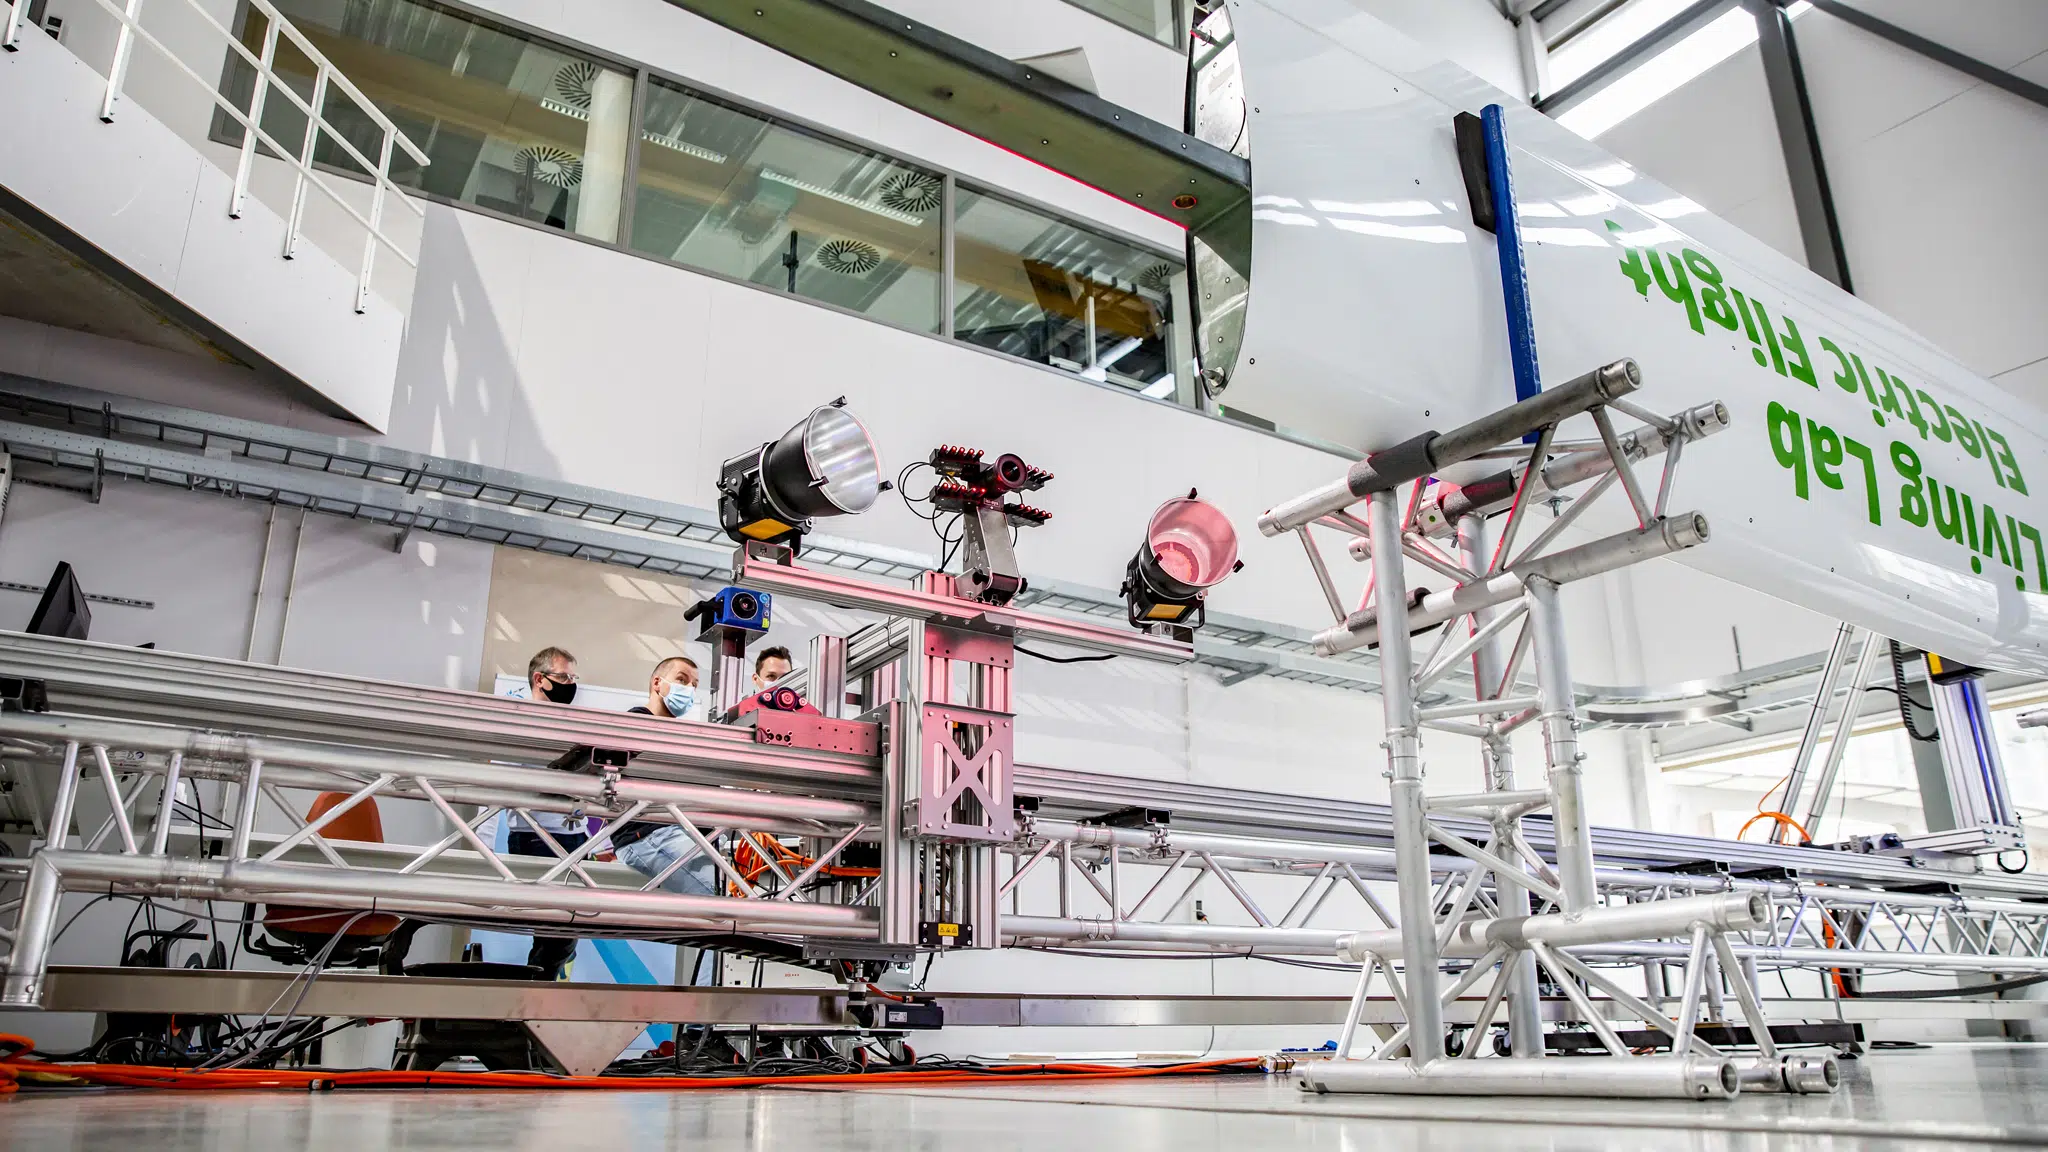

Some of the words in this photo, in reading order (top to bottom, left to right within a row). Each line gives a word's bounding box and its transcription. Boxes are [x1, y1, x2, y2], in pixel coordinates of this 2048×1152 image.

[1604, 219, 1819, 389] Flight
[1767, 400, 1882, 527] Lab
[1818, 336, 2029, 497] Electric
[1890, 441, 2048, 595] Living
